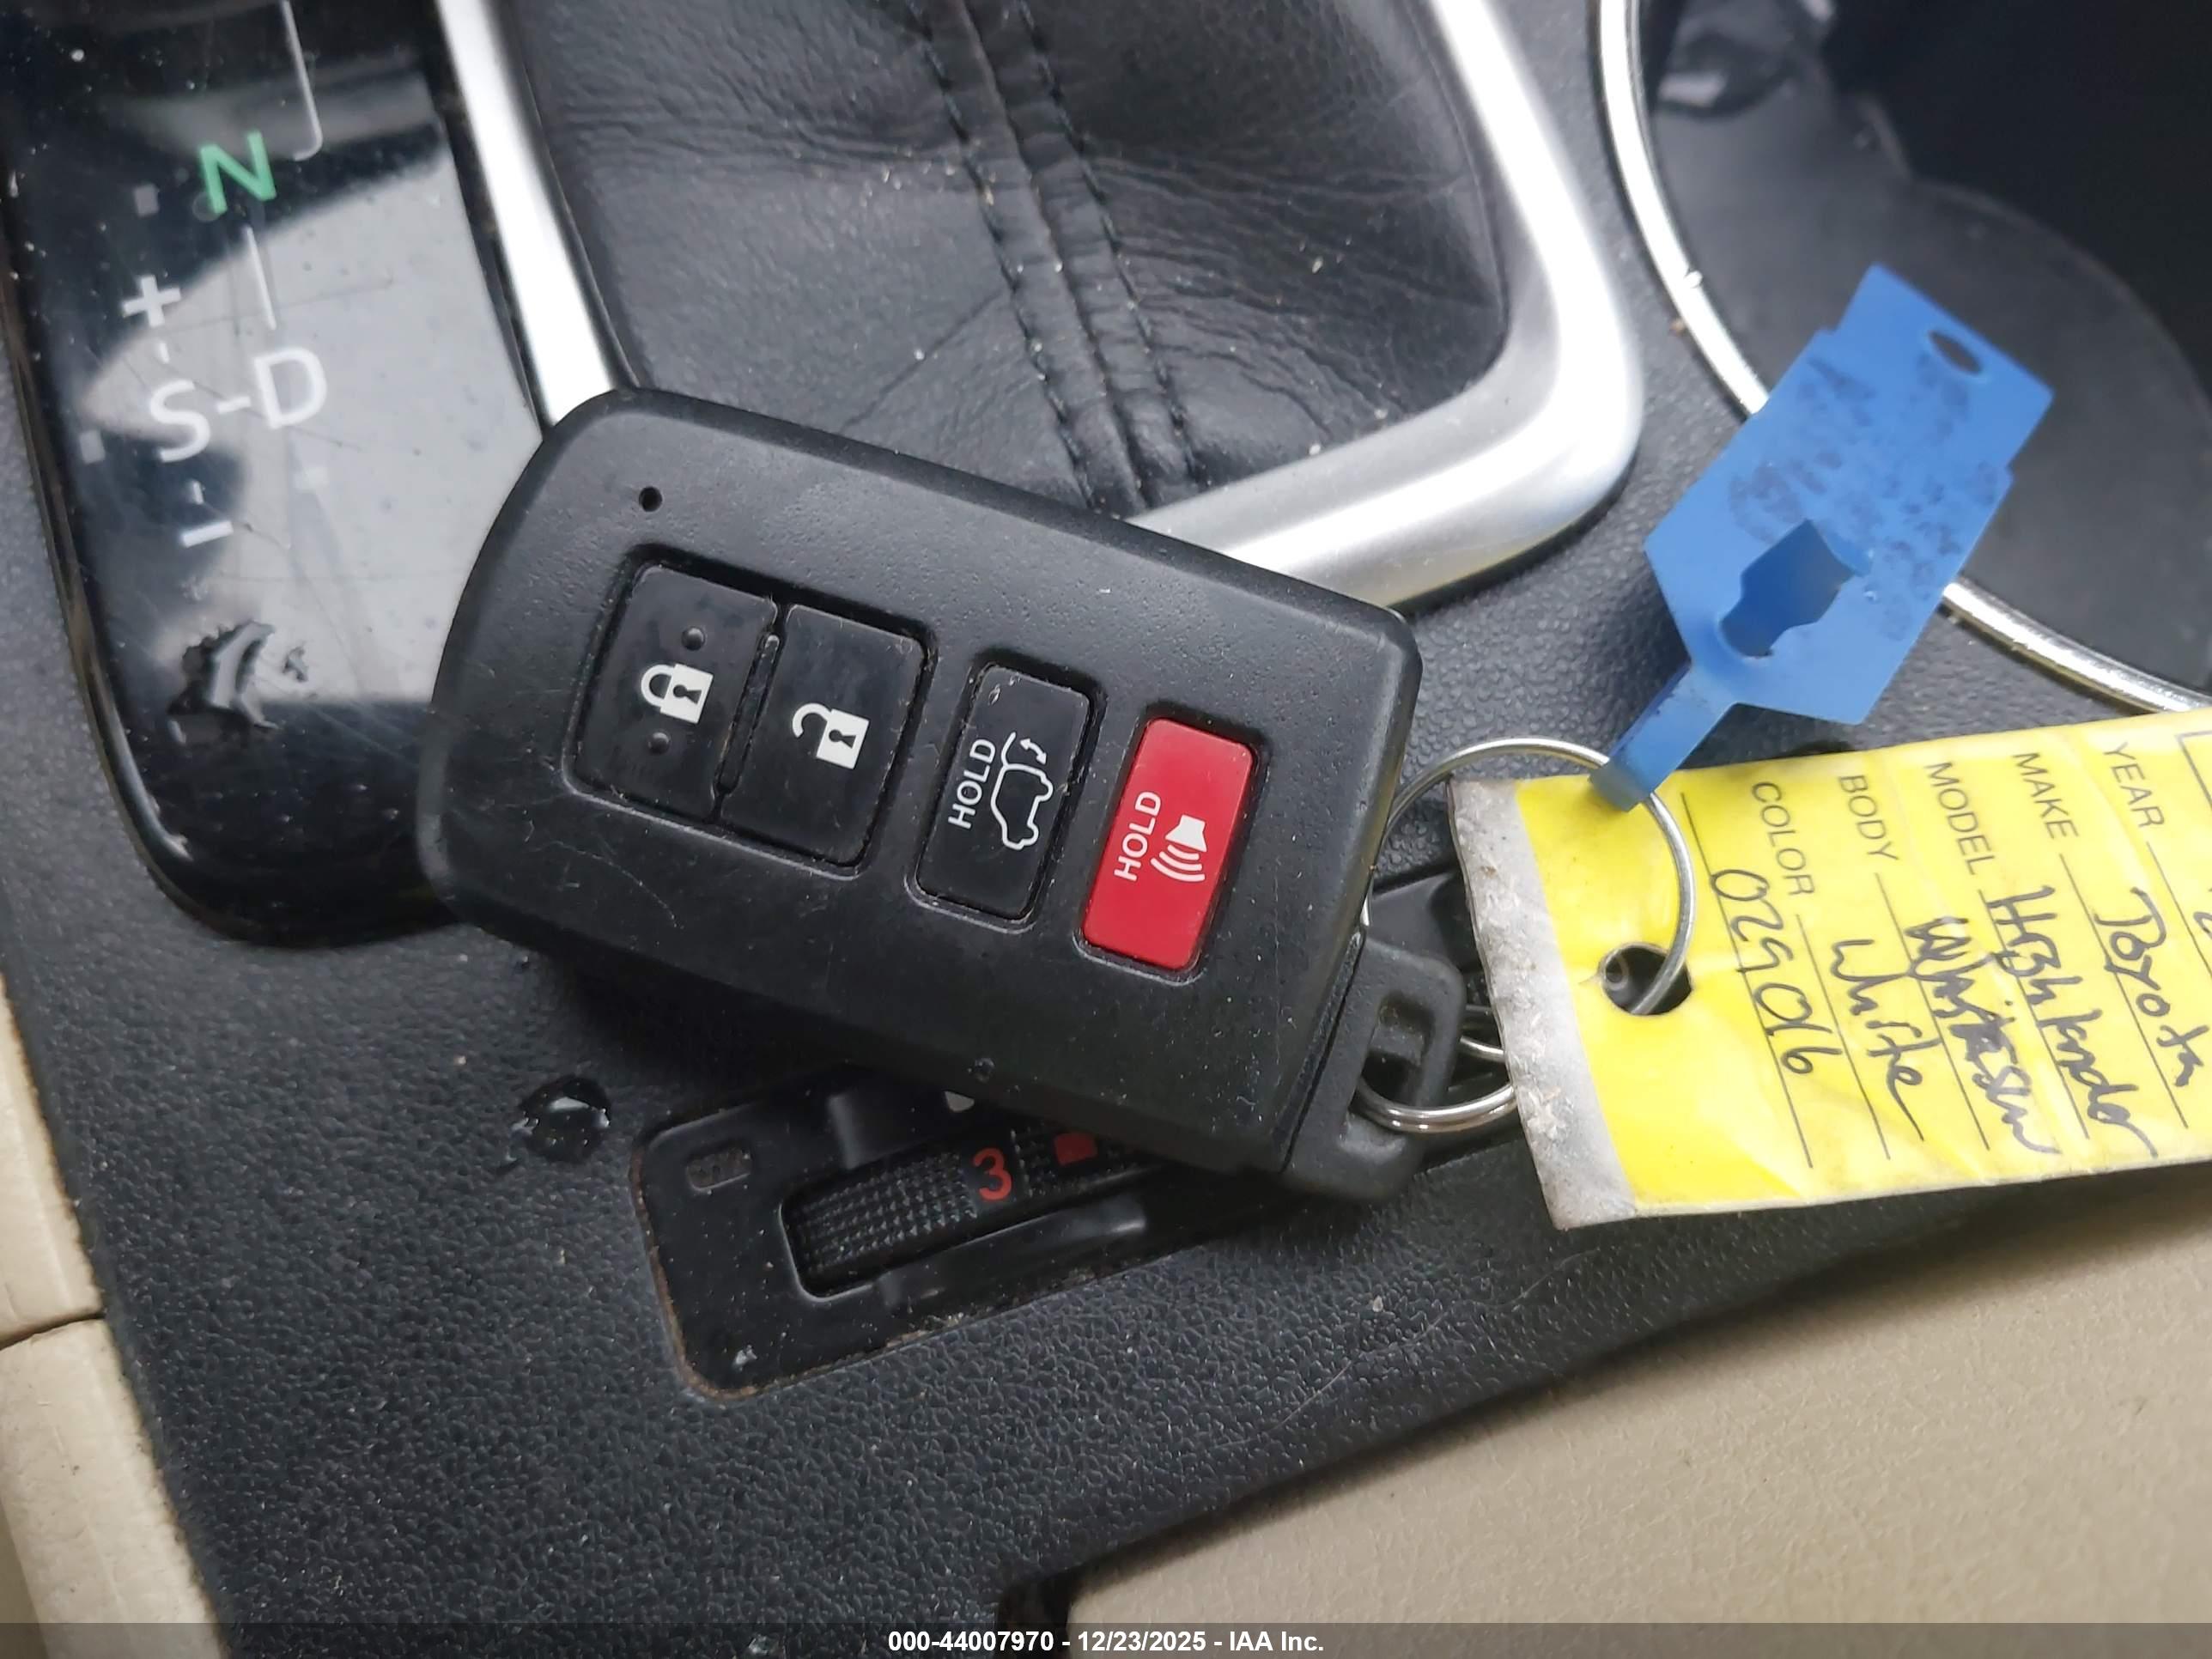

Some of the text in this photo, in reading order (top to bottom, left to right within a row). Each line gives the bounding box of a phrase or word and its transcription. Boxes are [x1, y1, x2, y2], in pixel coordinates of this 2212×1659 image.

[198, 131, 276, 213] N
[149, 347, 326, 462] S D
[948, 738, 996, 829] HOLD
[1838, 775, 1899, 860] BODY
[1924, 761, 1996, 876] MODEL
[2013, 752, 2079, 840] MAKE
[2104, 742, 2165, 828] YEAR
[1114, 791, 1161, 881] HOLD
[1751, 781, 1815, 896] COLOR
[2094, 886, 2210, 1087] Toyota
[1831, 939, 1942, 1142] White
[972, 1148, 1012, 1200] 3
